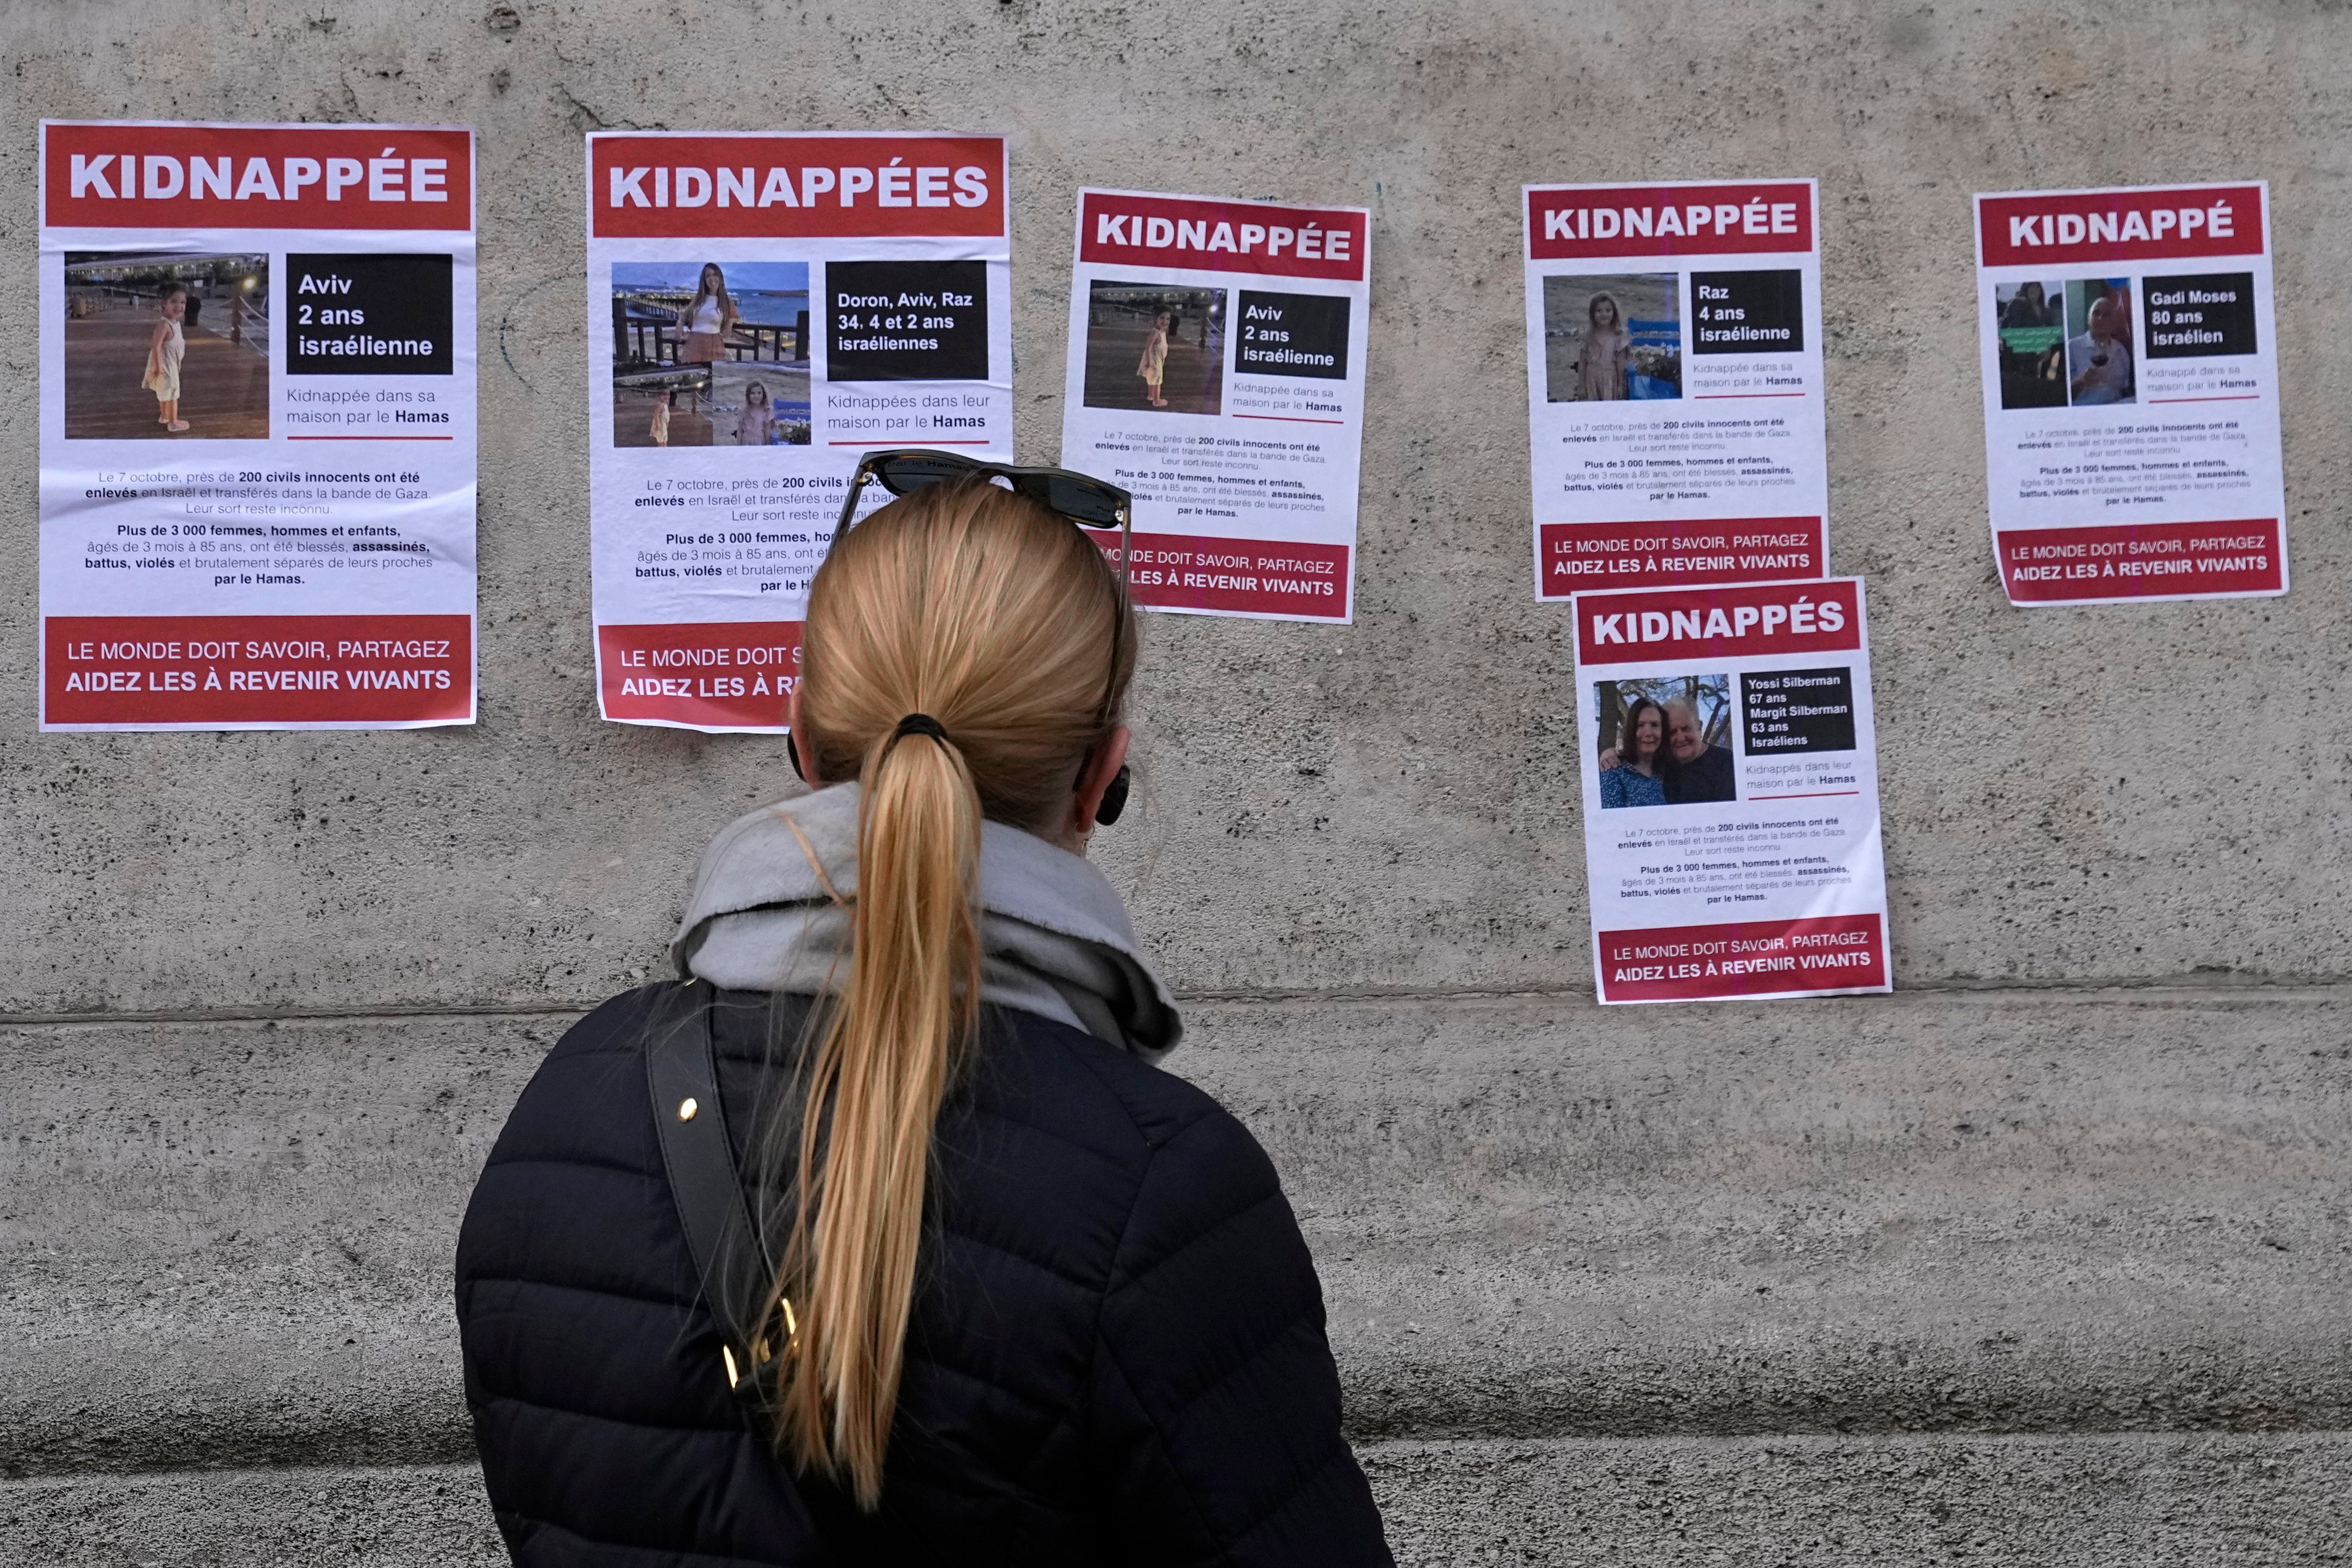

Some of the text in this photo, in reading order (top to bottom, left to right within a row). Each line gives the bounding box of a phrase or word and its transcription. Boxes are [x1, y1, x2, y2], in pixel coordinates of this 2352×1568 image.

[71, 149, 447, 202] KIDNAPPÉE
[610, 157, 988, 207] KIDNAPPÉES
[1545, 198, 1797, 239] KIDNAPPÉE
[2010, 200, 2234, 246] KIDNAPPÉ
[1097, 214, 1351, 260] KIDNAPPÉE
[298, 275, 352, 294] Aviv
[1700, 286, 1729, 299] Raz
[2151, 291, 2236, 305] Gadi Moses
[839, 293, 972, 309] Doron, Aviv, Raz
[299, 305, 364, 325] 2 ans
[1246, 305, 1282, 320] Aviv
[1700, 306, 1745, 320] 4 ans
[2152, 311, 2202, 325] 80 ans
[839, 314, 954, 329] 34, 4 et 2 ans
[1245, 326, 1289, 342] 2 ans
[1701, 327, 1790, 341] israélienne
[2153, 329, 2223, 345] israélien
[300, 335, 432, 355] israélienne
[839, 336, 938, 350] israéliennes
[1244, 346, 1334, 366] israélienne
[1693, 363, 1749, 374] Kidnappée
[1752, 363, 1777, 372] dans
[1766, 377, 1803, 385] Hamas
[288, 389, 435, 404] Kidnappée dans sa
[1234, 383, 1290, 395] Kidnappée
[1293, 387, 1318, 397] dans
[828, 395, 989, 410] Kidnappées dans leur
[1234, 399, 1269, 407] maison
[1306, 401, 1342, 412] Hamas
[288, 410, 449, 425] maison par le Hamas
[829, 415, 985, 430] maison par le Hamas
[118, 525, 400, 537] Plus de 3 000 femmes, hommes et enfants,
[667, 533, 810, 544] Plus de 3 000 femmes,
[1555, 534, 1808, 553] LE MONDE DOIT SAVOIR, PARTAGEZ
[2012, 536, 2265, 560] LE MONDE DOIT SAVOIR, PARTAGEZ
[1158, 551, 1334, 574] DOIT SAVOIR, PARTAGEZ
[1555, 554, 1809, 574] AIDEZ LES À REVENIR VIVANTS
[2013, 556, 2267, 581] AIDEZ LES À REVENIR VIVANTS
[1131, 569, 1333, 595] LES À REVENIR VIVANTS
[1594, 596, 1844, 644] KIDNAPPÉS
[69, 640, 450, 660] LE MONDE DOIT SAVOIR, PARTAGEZ
[622, 650, 646, 667] LE
[653, 649, 729, 666] MONDE
[737, 647, 786, 665] DOIT
[66, 667, 450, 691] AIDEZ LES À REVENIR VIVANTS
[622, 678, 692, 697] AIDEZ
[700, 678, 744, 697] LES
[753, 672, 769, 695] À
[1749, 677, 1840, 689] Yossi Silberman
[1749, 694, 1786, 704] 67 ans
[1750, 705, 1847, 720] Margit Silberman
[1751, 723, 1788, 733] 63 ans
[1752, 736, 1807, 747] Israéliens
[1746, 761, 1851, 775] Kidnappés dans leur
[1787, 779, 1803, 787] par
[1819, 776, 1856, 784] Hamas
[1614, 932, 1868, 960] LE MONDE DOIT SAVOIR, PARTAGEZ
[1615, 952, 1871, 981] AIDEZ LES À REVENIR VIVANTS
